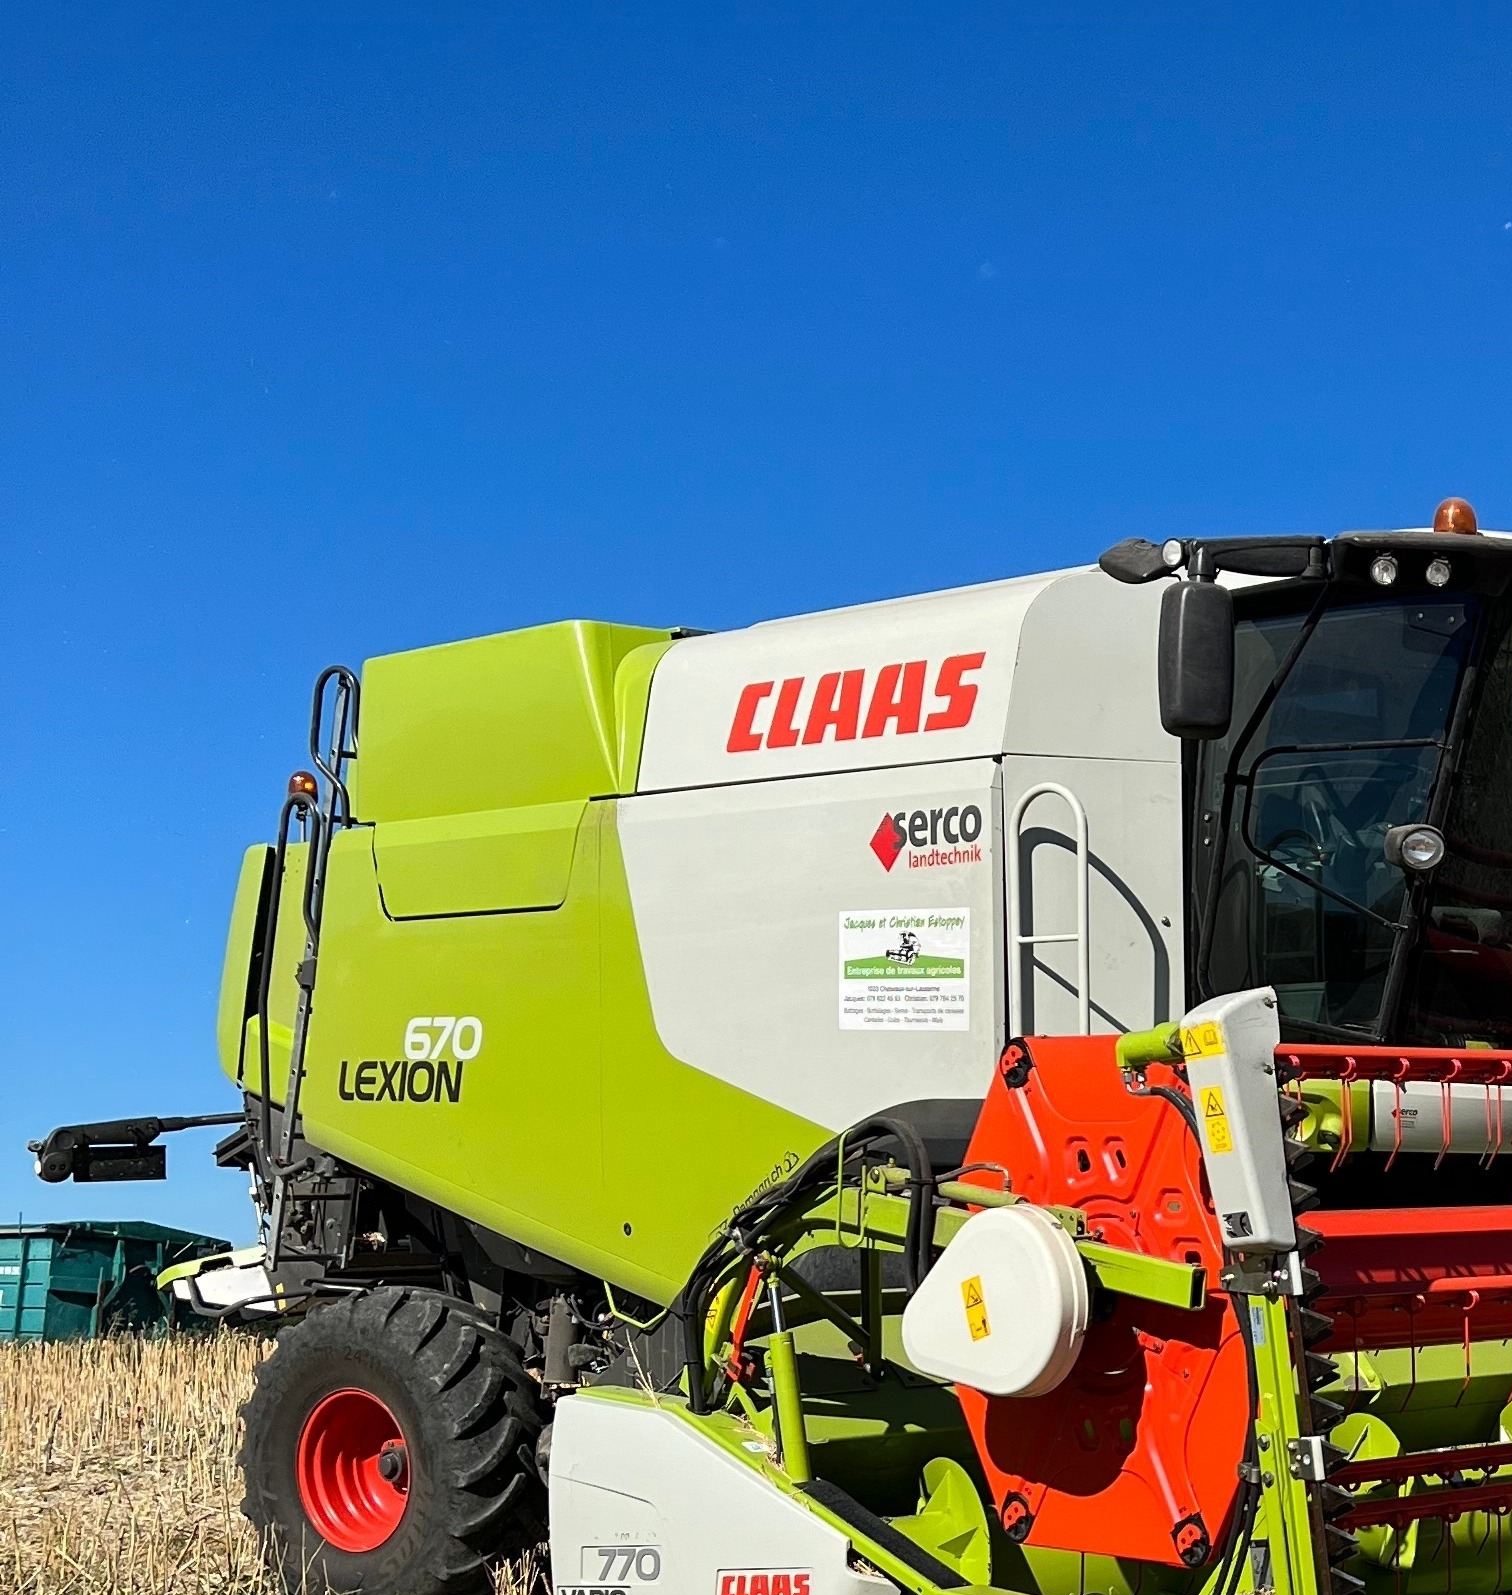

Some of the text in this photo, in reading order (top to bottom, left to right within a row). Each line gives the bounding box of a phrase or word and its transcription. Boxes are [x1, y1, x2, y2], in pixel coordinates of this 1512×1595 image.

[726, 651, 986, 752] CLAAS
[892, 804, 982, 851] serco
[908, 844, 982, 868] landtechnik
[844, 916, 876, 932] Jacques
[878, 916, 886, 929] et
[889, 915, 925, 929] Christian
[847, 965, 961, 977] Entreprise de travaux agricoles
[404, 1016, 483, 1060] 670
[338, 1060, 464, 1103] LEXION
[1398, 1108, 1418, 1116] erco
[598, 1548, 661, 1581] 770
